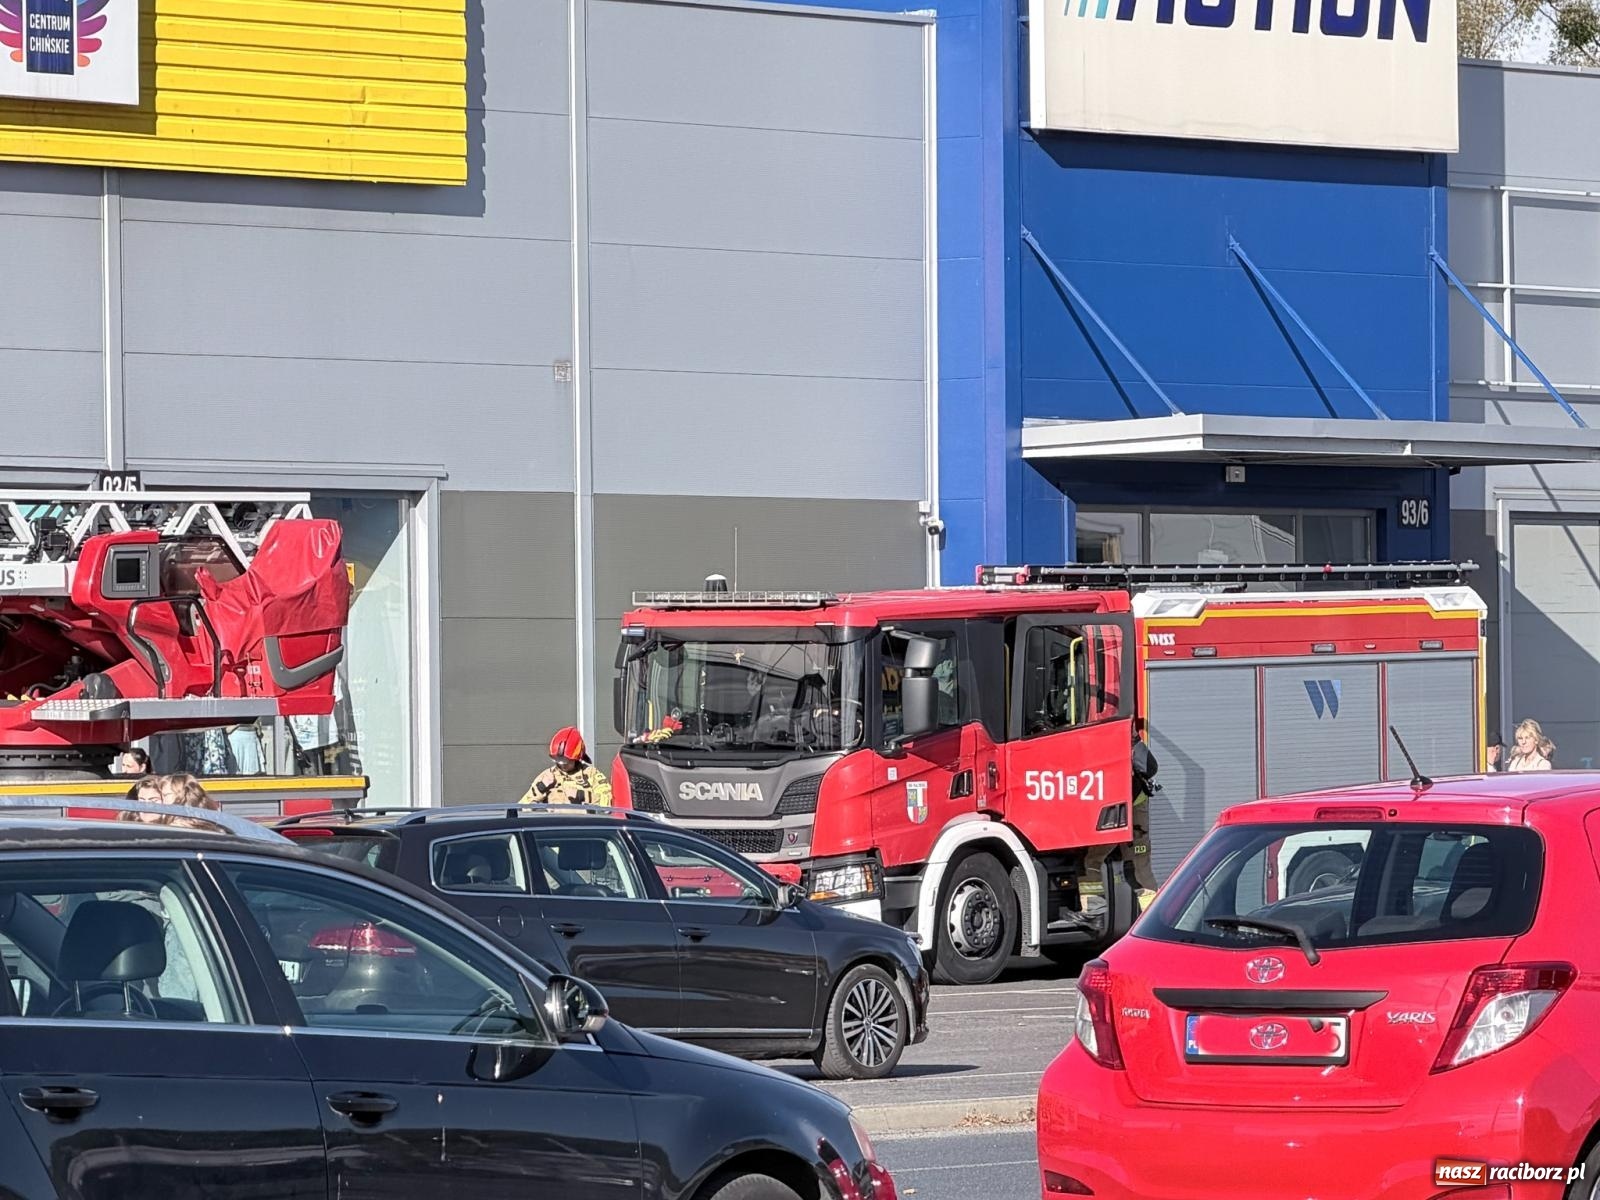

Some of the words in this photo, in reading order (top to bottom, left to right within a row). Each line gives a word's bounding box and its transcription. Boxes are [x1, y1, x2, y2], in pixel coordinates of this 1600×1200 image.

[29, 13, 71, 32] CENTRUM
[29, 34, 70, 55] CHIŃSKIE
[1402, 499, 1429, 528] 93/6
[678, 781, 764, 801] SCANIA
